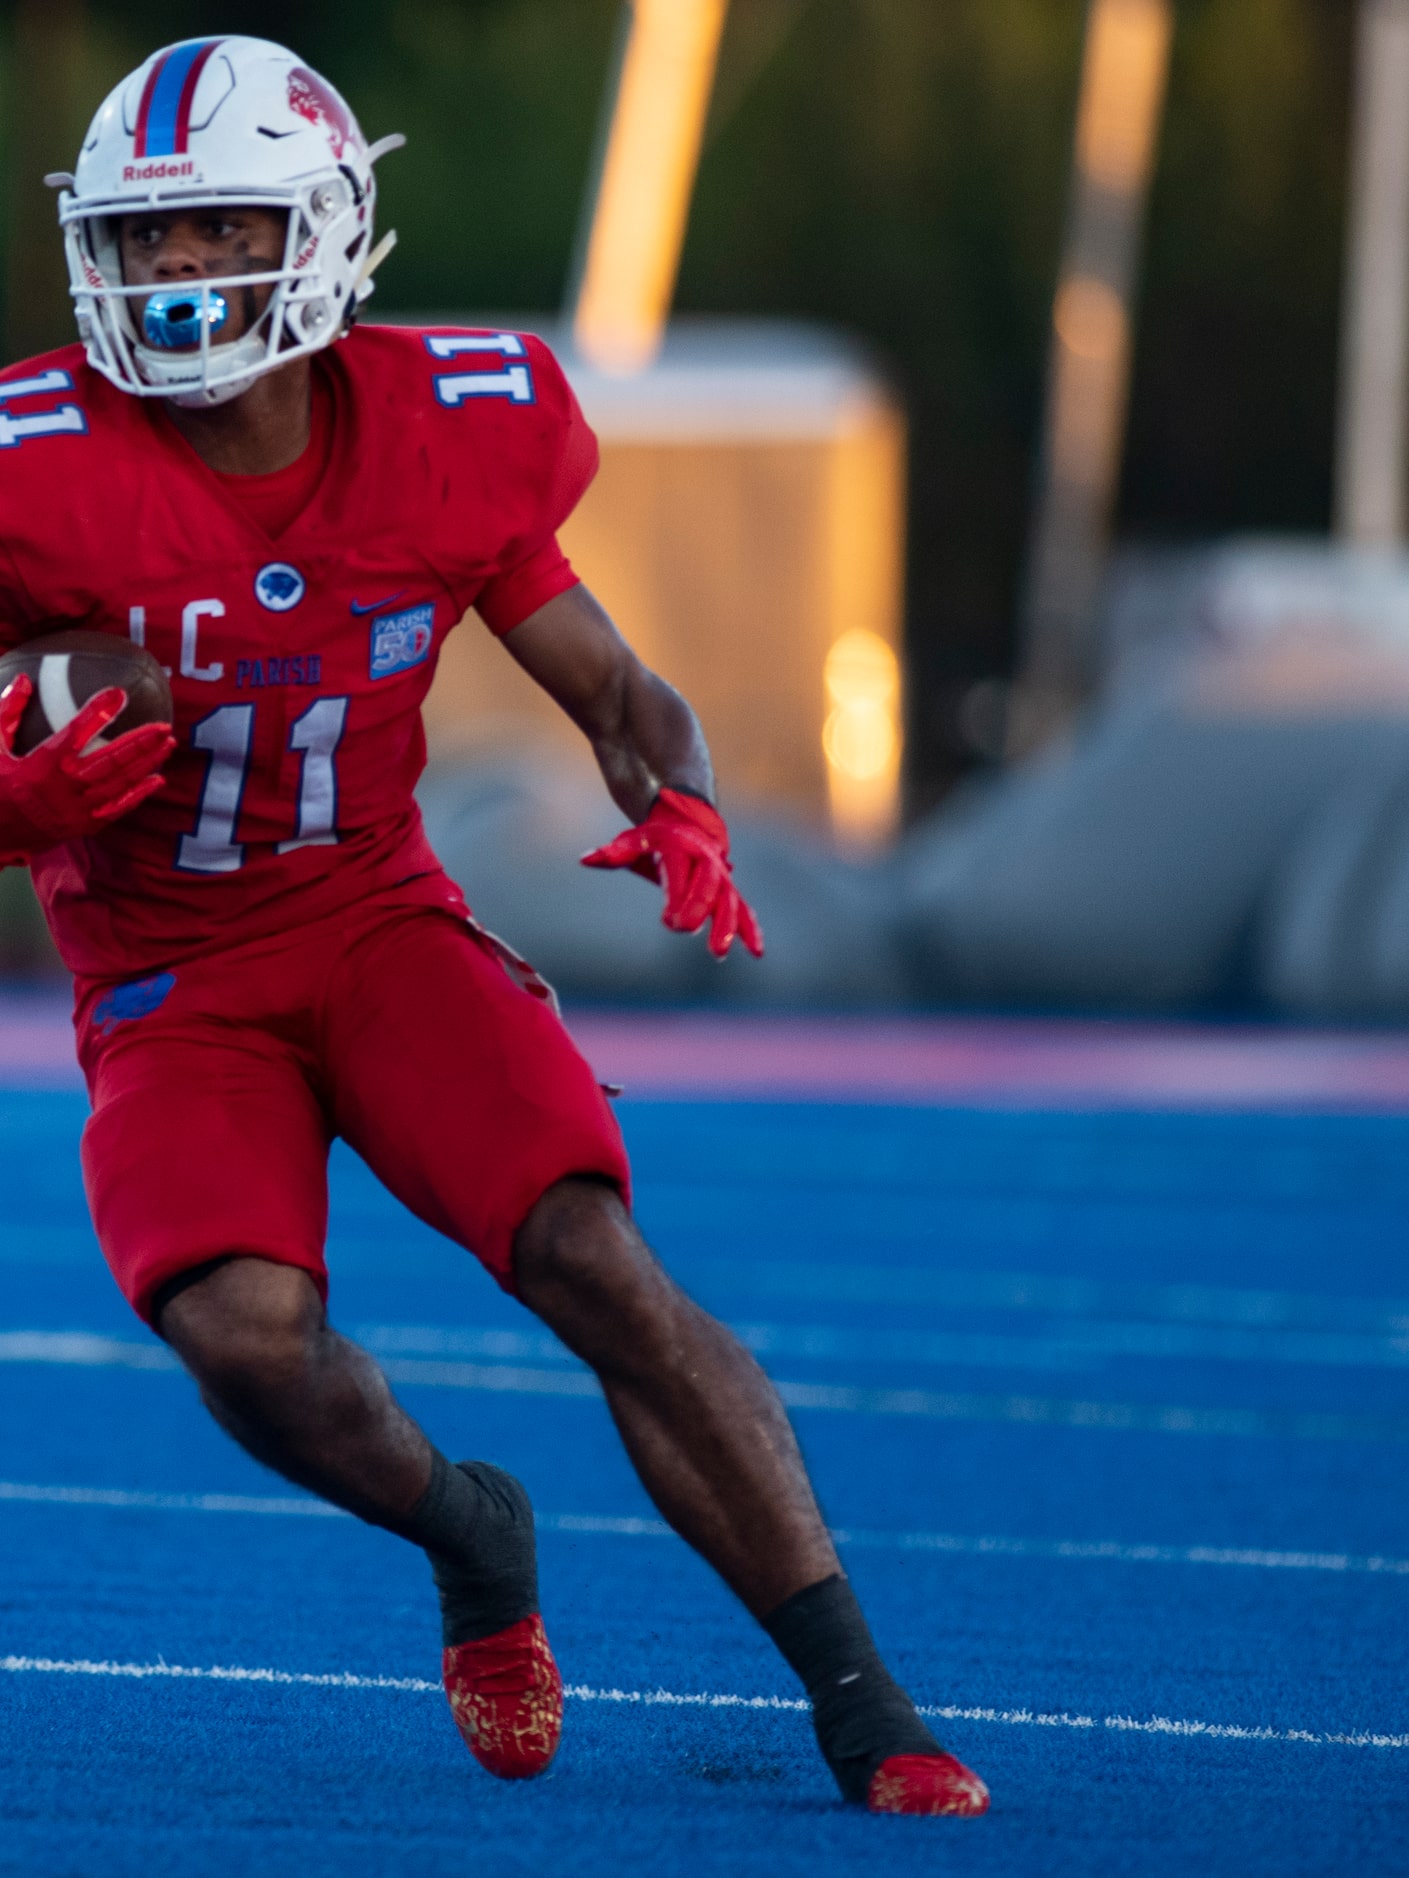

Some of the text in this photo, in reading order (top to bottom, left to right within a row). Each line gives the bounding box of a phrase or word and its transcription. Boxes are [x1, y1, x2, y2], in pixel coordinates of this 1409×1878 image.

[123, 161, 194, 181] Riddell
[423, 332, 537, 408] 11
[374, 607, 433, 634] PARISH
[372, 623, 431, 670] 50
[235, 654, 321, 688] PARISH
[174, 694, 351, 875] 11
